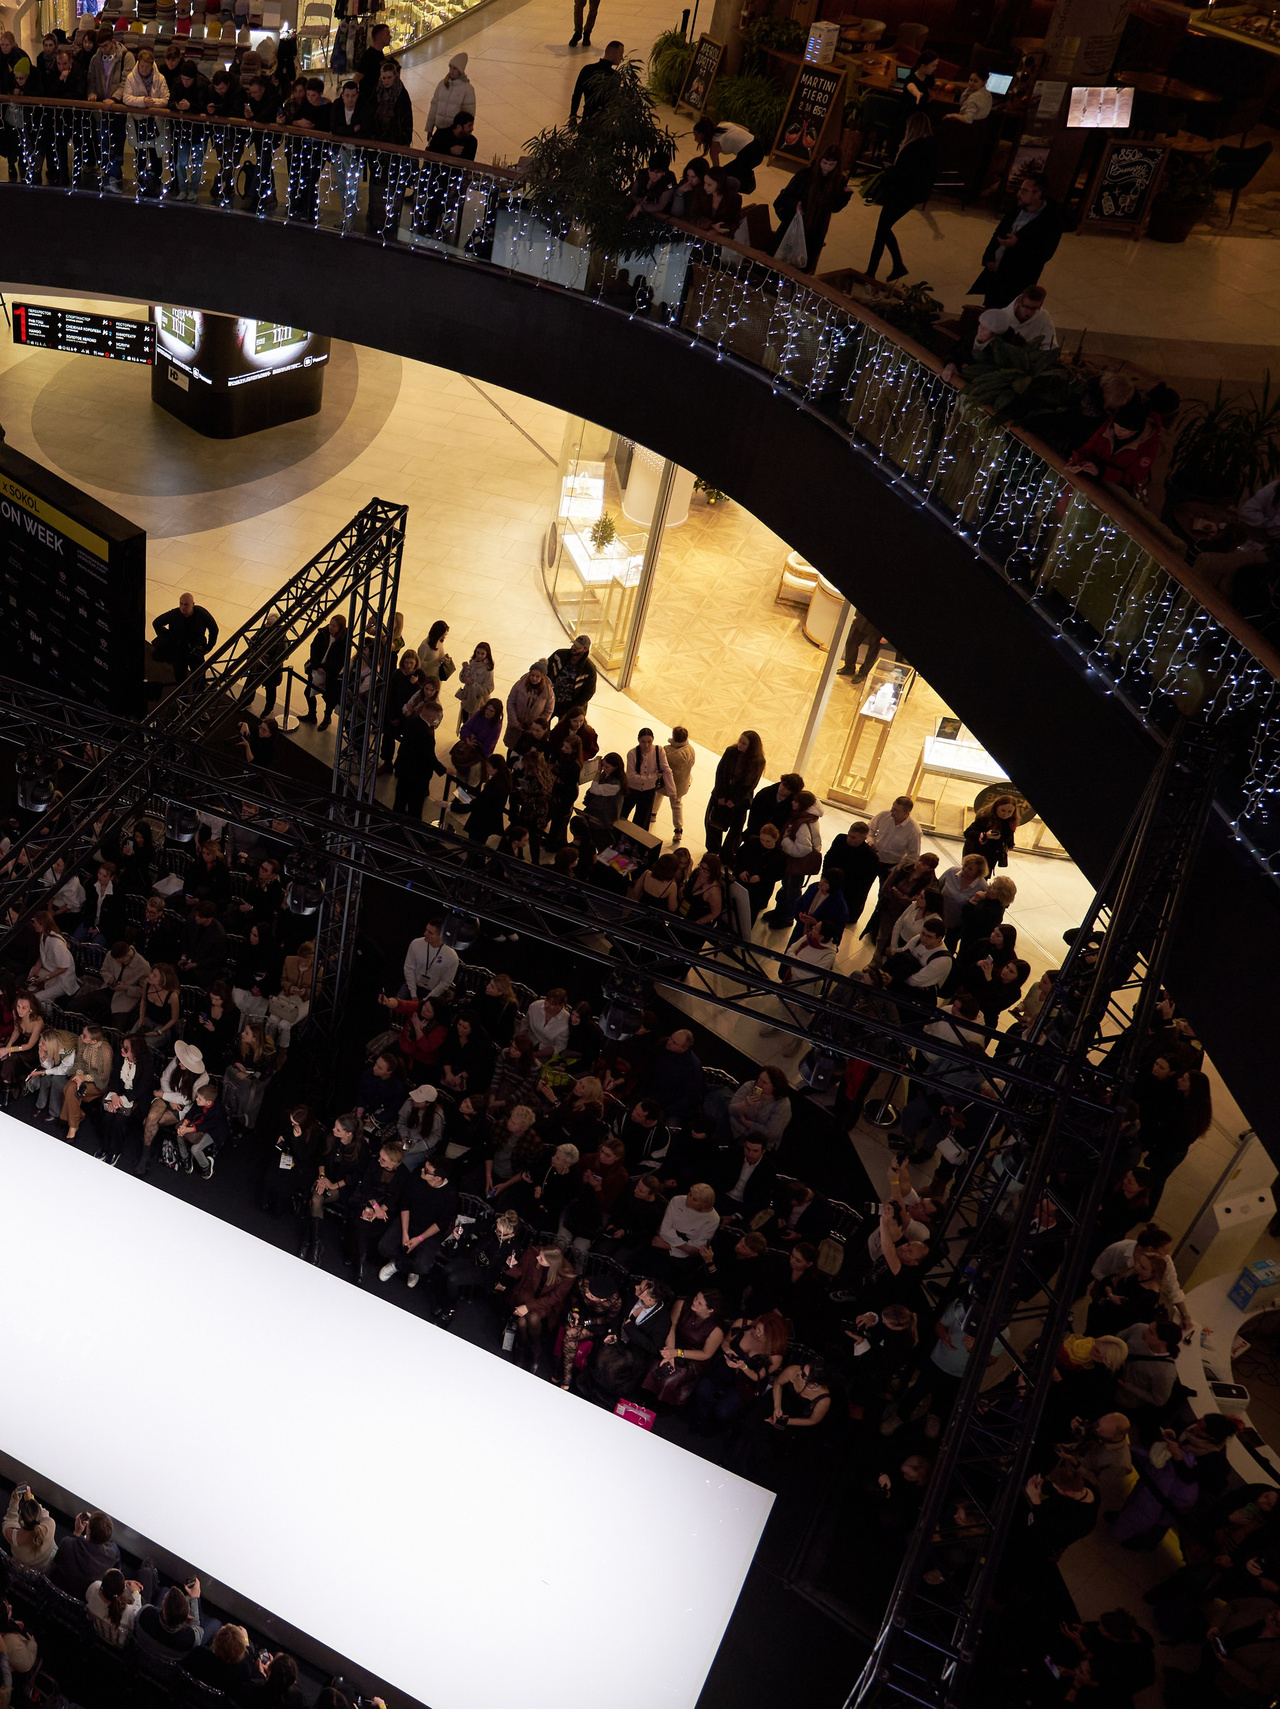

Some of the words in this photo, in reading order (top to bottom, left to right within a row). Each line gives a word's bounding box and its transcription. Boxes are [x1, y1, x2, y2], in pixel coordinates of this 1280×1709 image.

[800, 73, 837, 93] MARTINI
[801, 87, 828, 104] FIERO
[798, 101, 804, 111] 2
[812, 104, 827, 117] 850
[14, 306, 26, 342] 1
[170, 368, 179, 381] HD
[2, 482, 8, 492] x
[9, 484, 40, 513] SOKOL
[23, 514, 64, 556] WEEK
